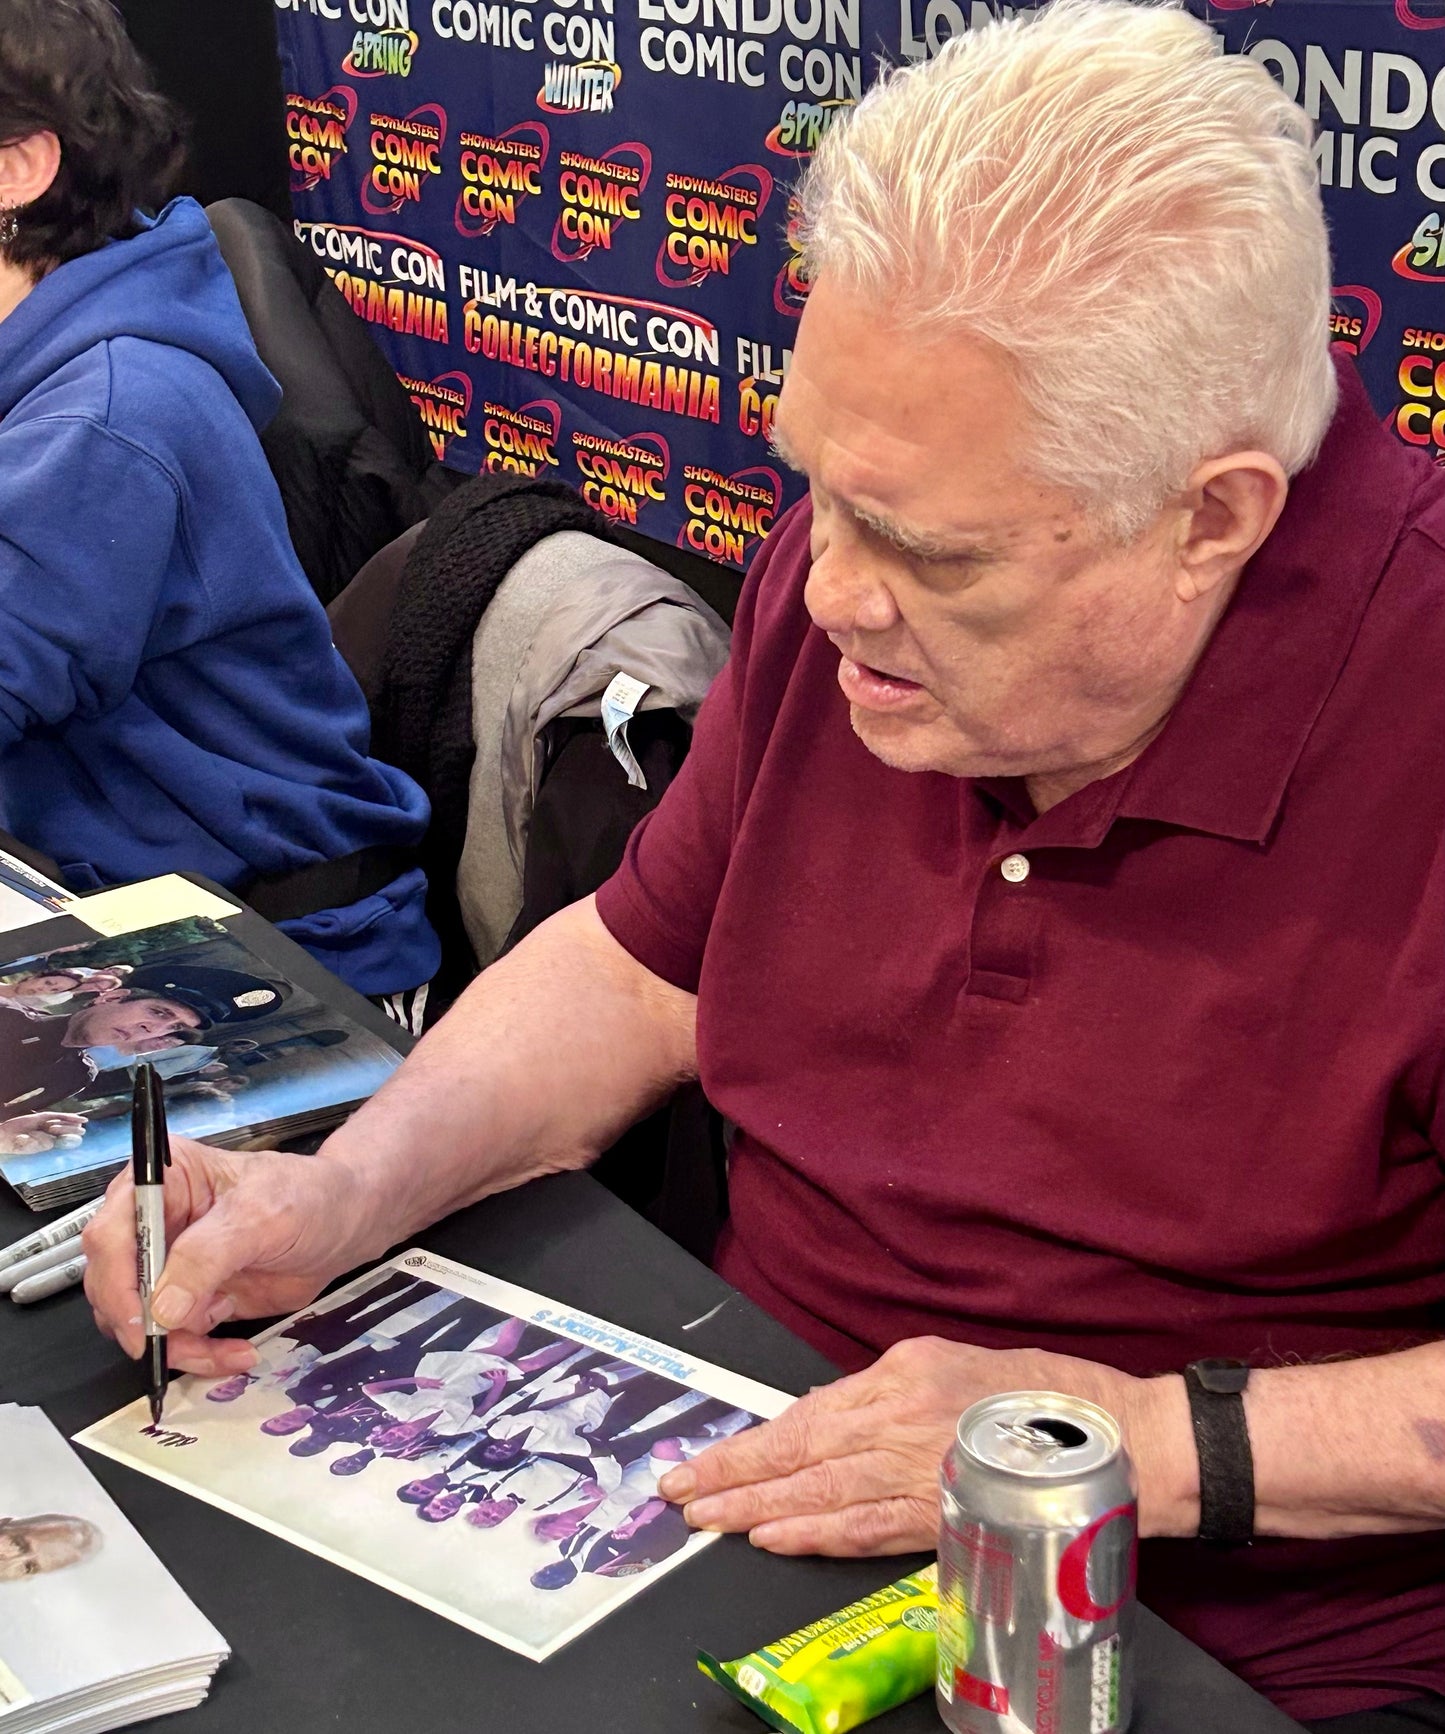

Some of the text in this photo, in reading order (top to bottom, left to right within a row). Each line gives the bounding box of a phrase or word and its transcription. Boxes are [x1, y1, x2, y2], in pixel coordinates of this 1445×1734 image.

[352, 31, 411, 77] SPRING
[431, 0, 615, 64] COMIC CON
[640, 27, 862, 99] COMIC CON
[544, 60, 614, 113] WINTER
[370, 113, 439, 140] SHOWMASTERS
[460, 132, 541, 159] SHOWMASTERS
[289, 143, 331, 180] CON
[370, 131, 441, 174] COMIC
[460, 151, 542, 195] COMIC
[560, 151, 640, 182] SHOWMASTERS
[1311, 130, 1398, 194] MIC
[371, 164, 420, 202] CON
[462, 186, 515, 224] CON
[560, 170, 640, 219] COMIC
[666, 173, 757, 206] SHOWMASTERS
[561, 207, 611, 249] CON
[665, 193, 758, 245] COMIC
[311, 225, 383, 276] COMIC
[391, 247, 446, 292] CON
[667, 232, 729, 275] CON
[458, 265, 719, 366] FILM & COMIC CON
[463, 308, 720, 424] COLLECTORMANIA
[572, 432, 664, 467] SHOWMASTERS
[576, 450, 665, 501] COMIC
[683, 465, 774, 505] SHOWMASTERS
[583, 481, 636, 525] CON
[684, 483, 774, 540] COMIC
[687, 518, 744, 565] CON
